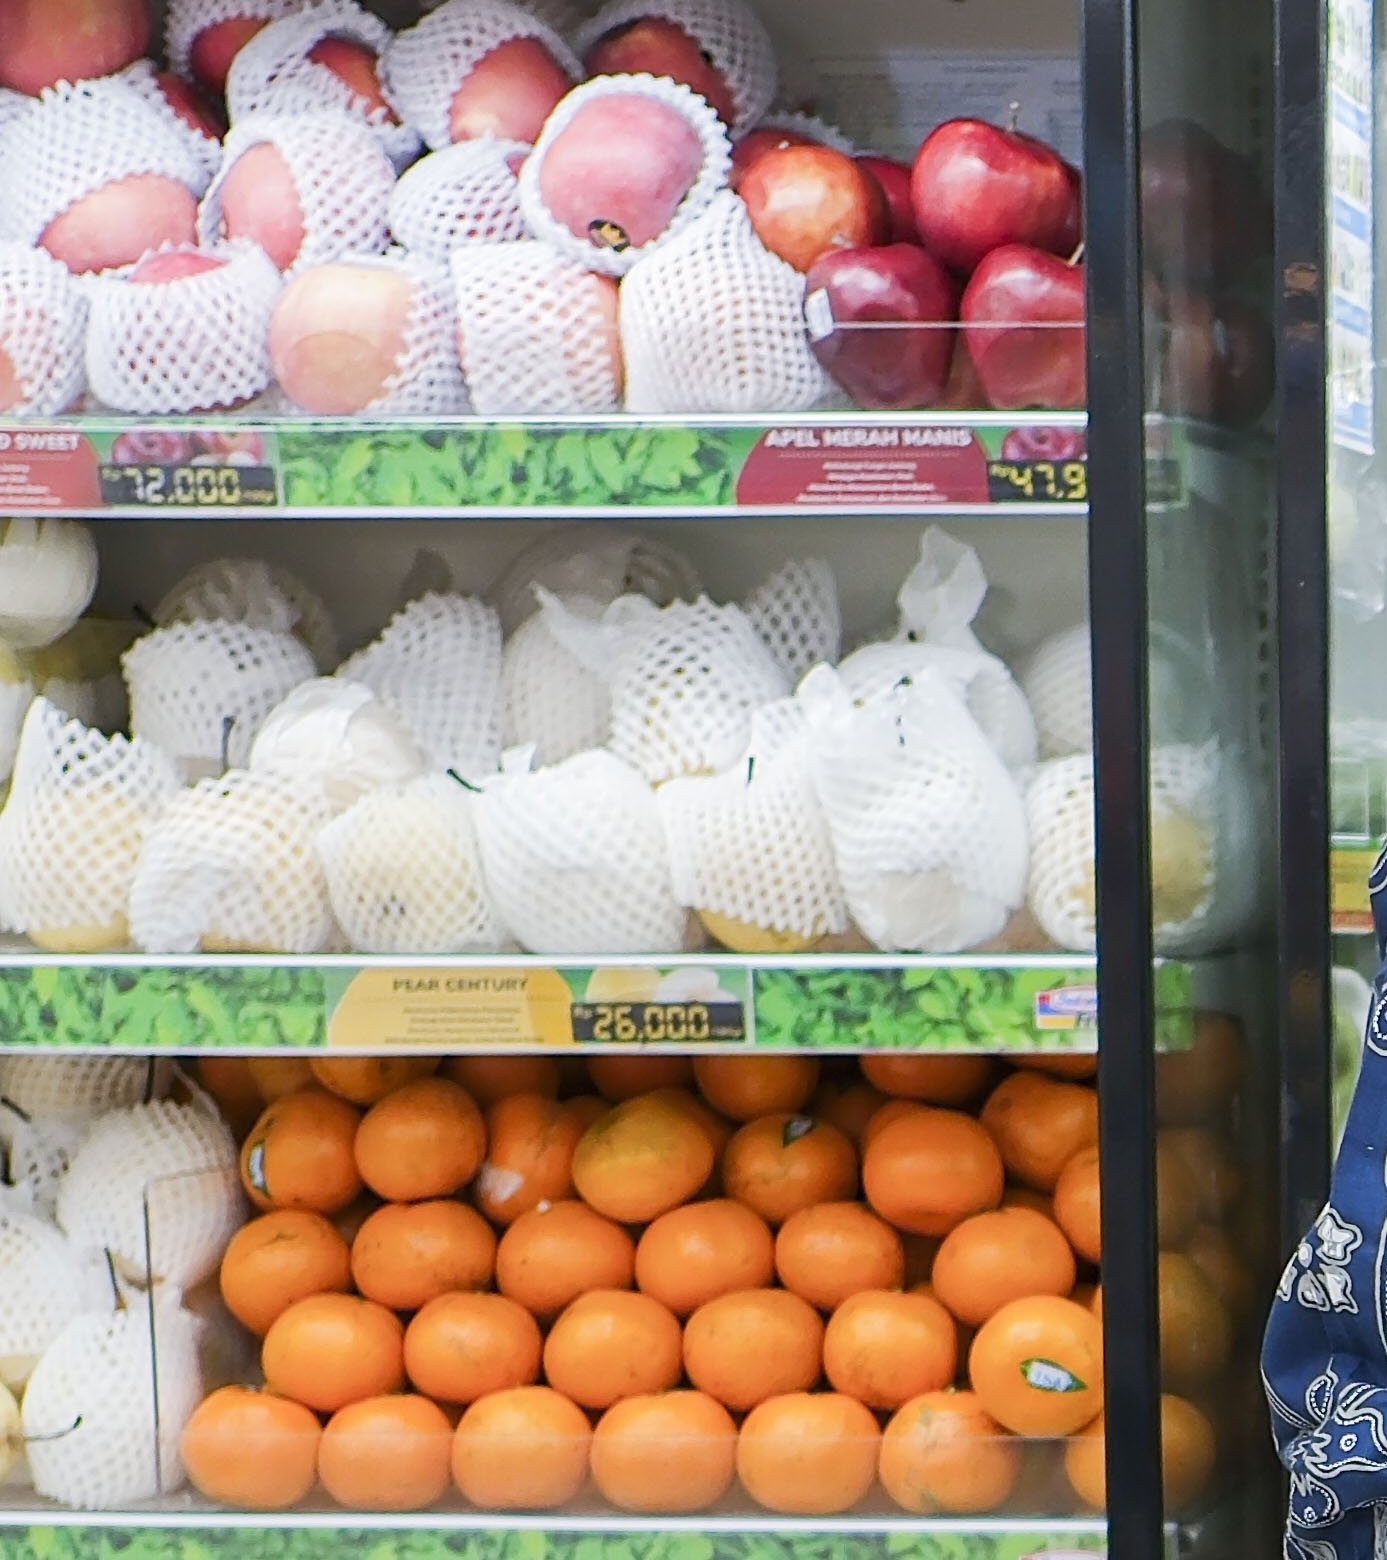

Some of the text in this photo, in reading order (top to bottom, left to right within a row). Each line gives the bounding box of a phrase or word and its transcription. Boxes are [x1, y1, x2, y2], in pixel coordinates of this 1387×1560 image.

[764, 428, 820, 448] APEL
[123, 466, 241, 504] 72.000
[1008, 462, 1086, 500] 47.9
[445, 977, 529, 992] CENTURY
[593, 1004, 709, 1040] 26.000
